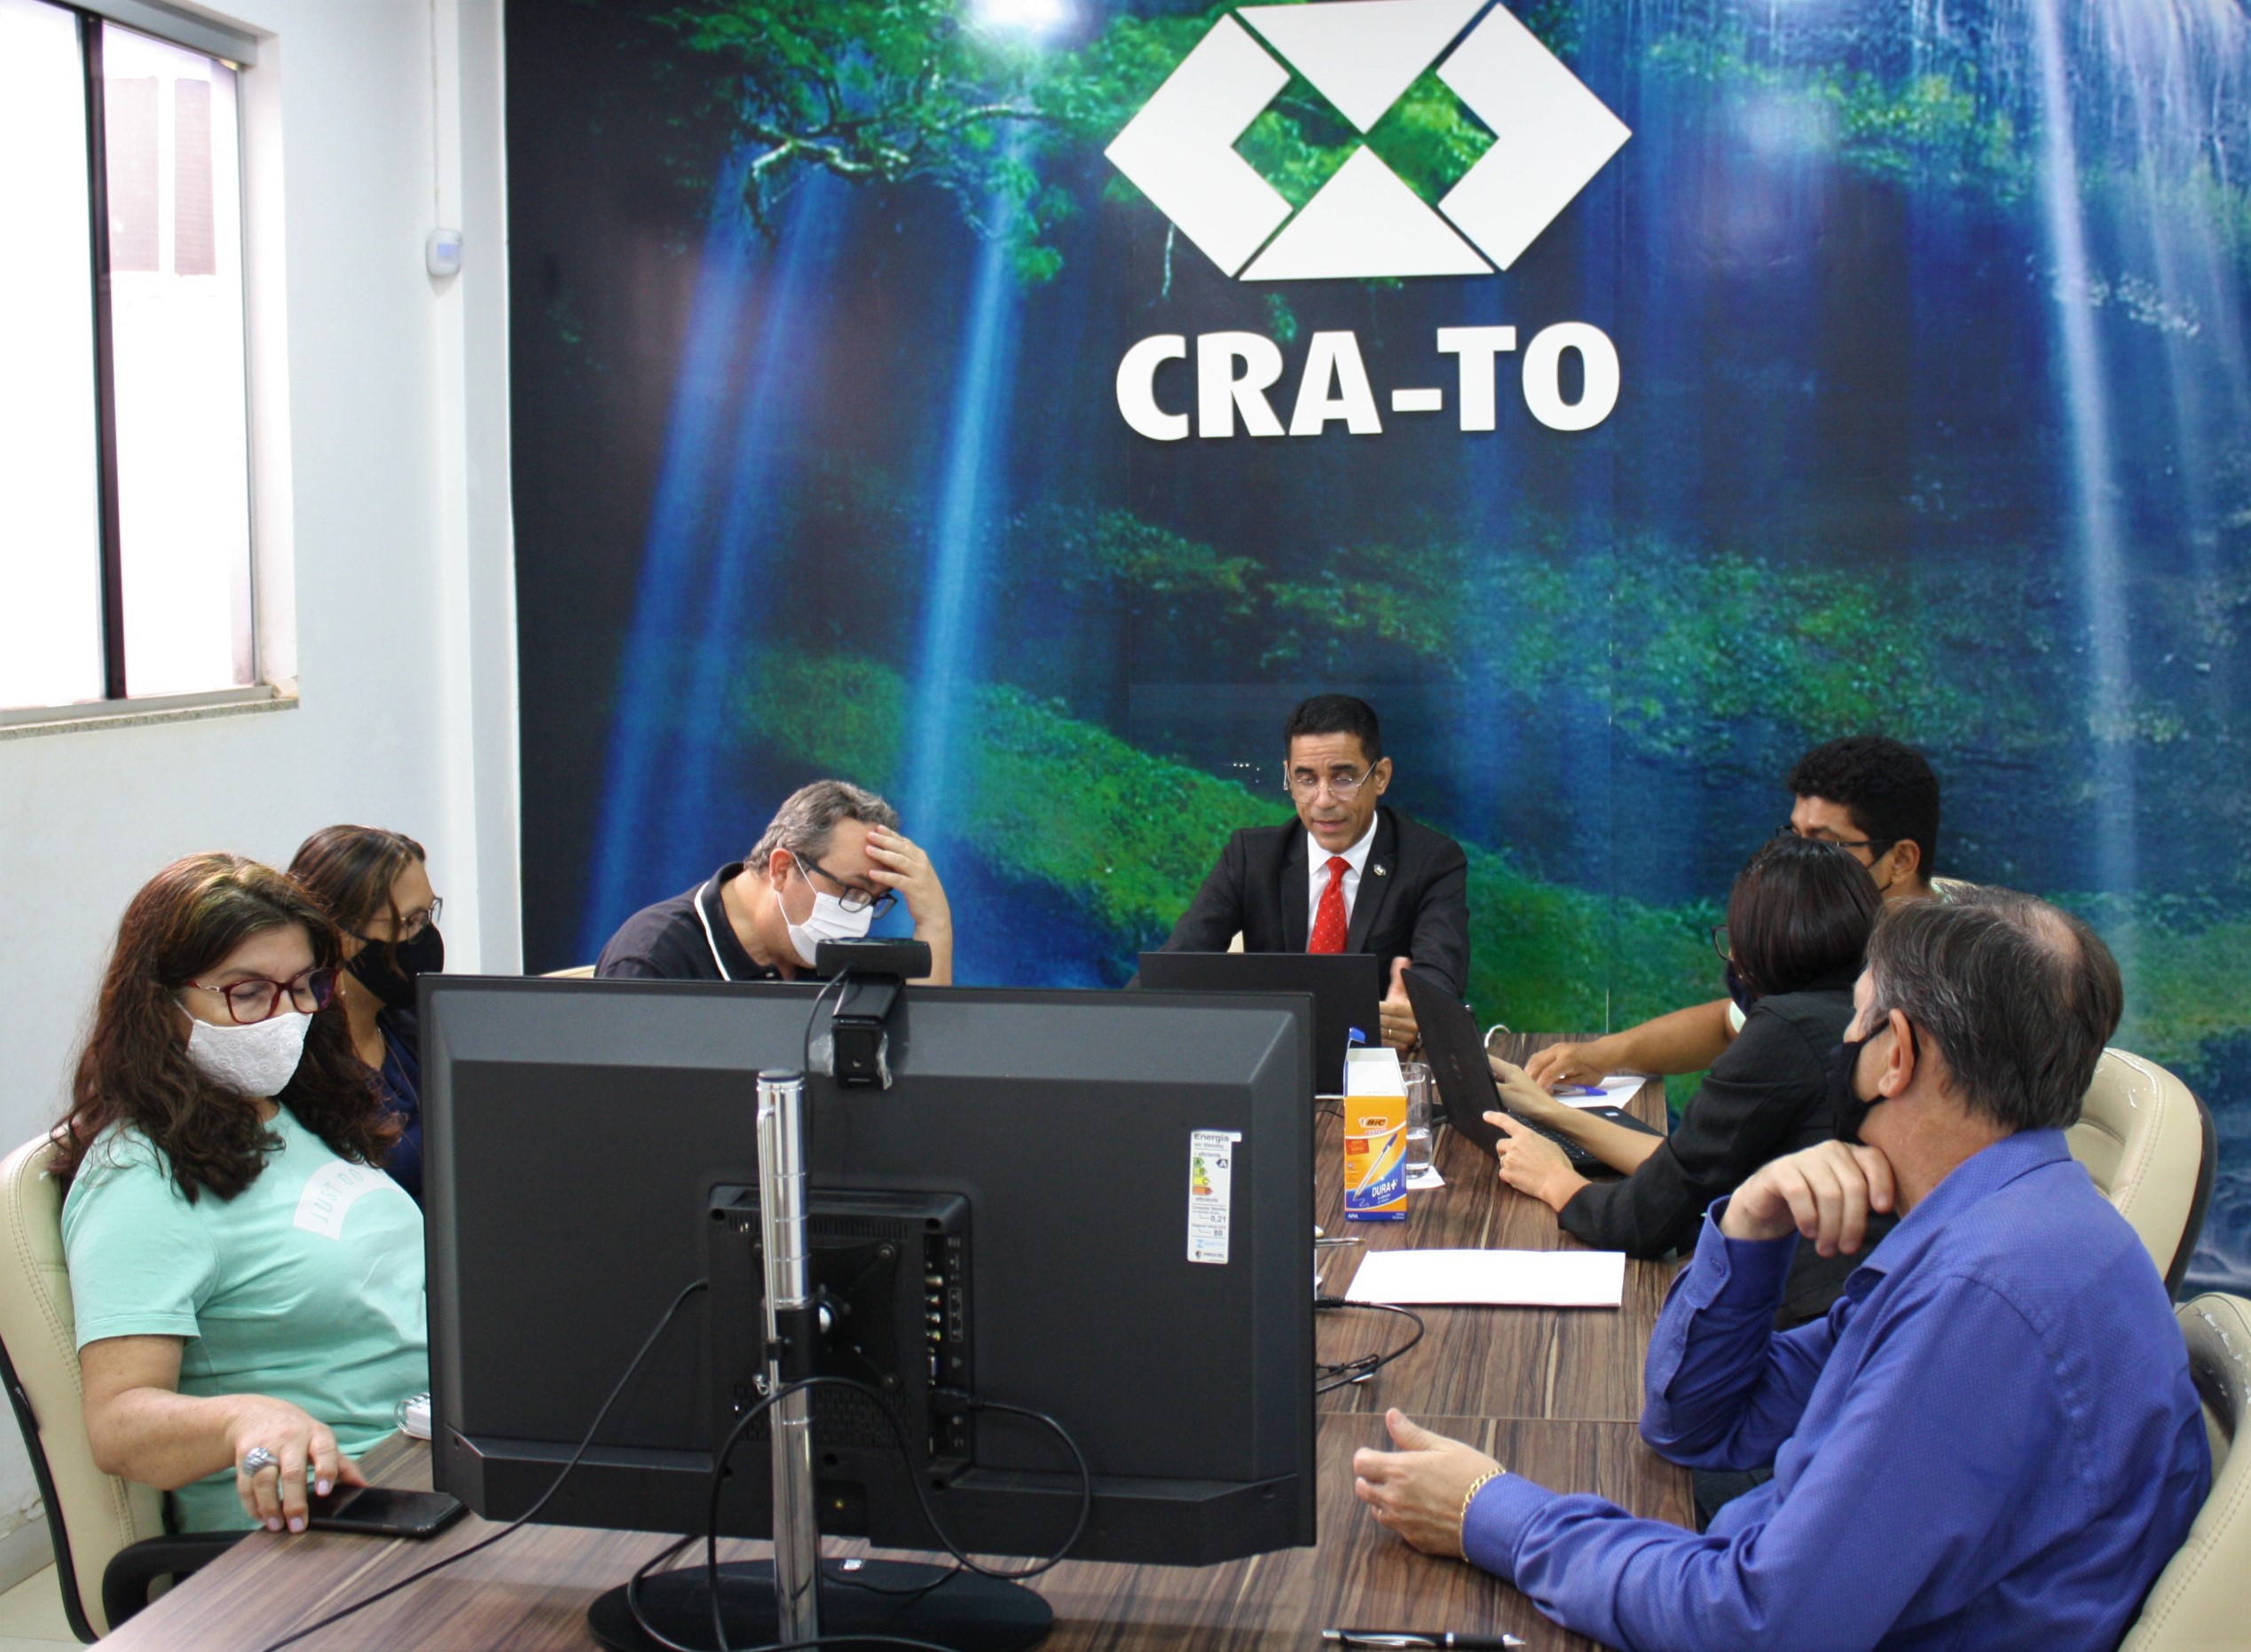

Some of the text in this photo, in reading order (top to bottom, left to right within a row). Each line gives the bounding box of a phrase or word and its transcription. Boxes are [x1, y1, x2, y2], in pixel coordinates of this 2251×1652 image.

[1115, 321, 1621, 442] CRA-TO
[1193, 1133, 1230, 1144] Energia
[311, 1181, 342, 1224] JUST
[1372, 1179, 1397, 1198] DURA+
